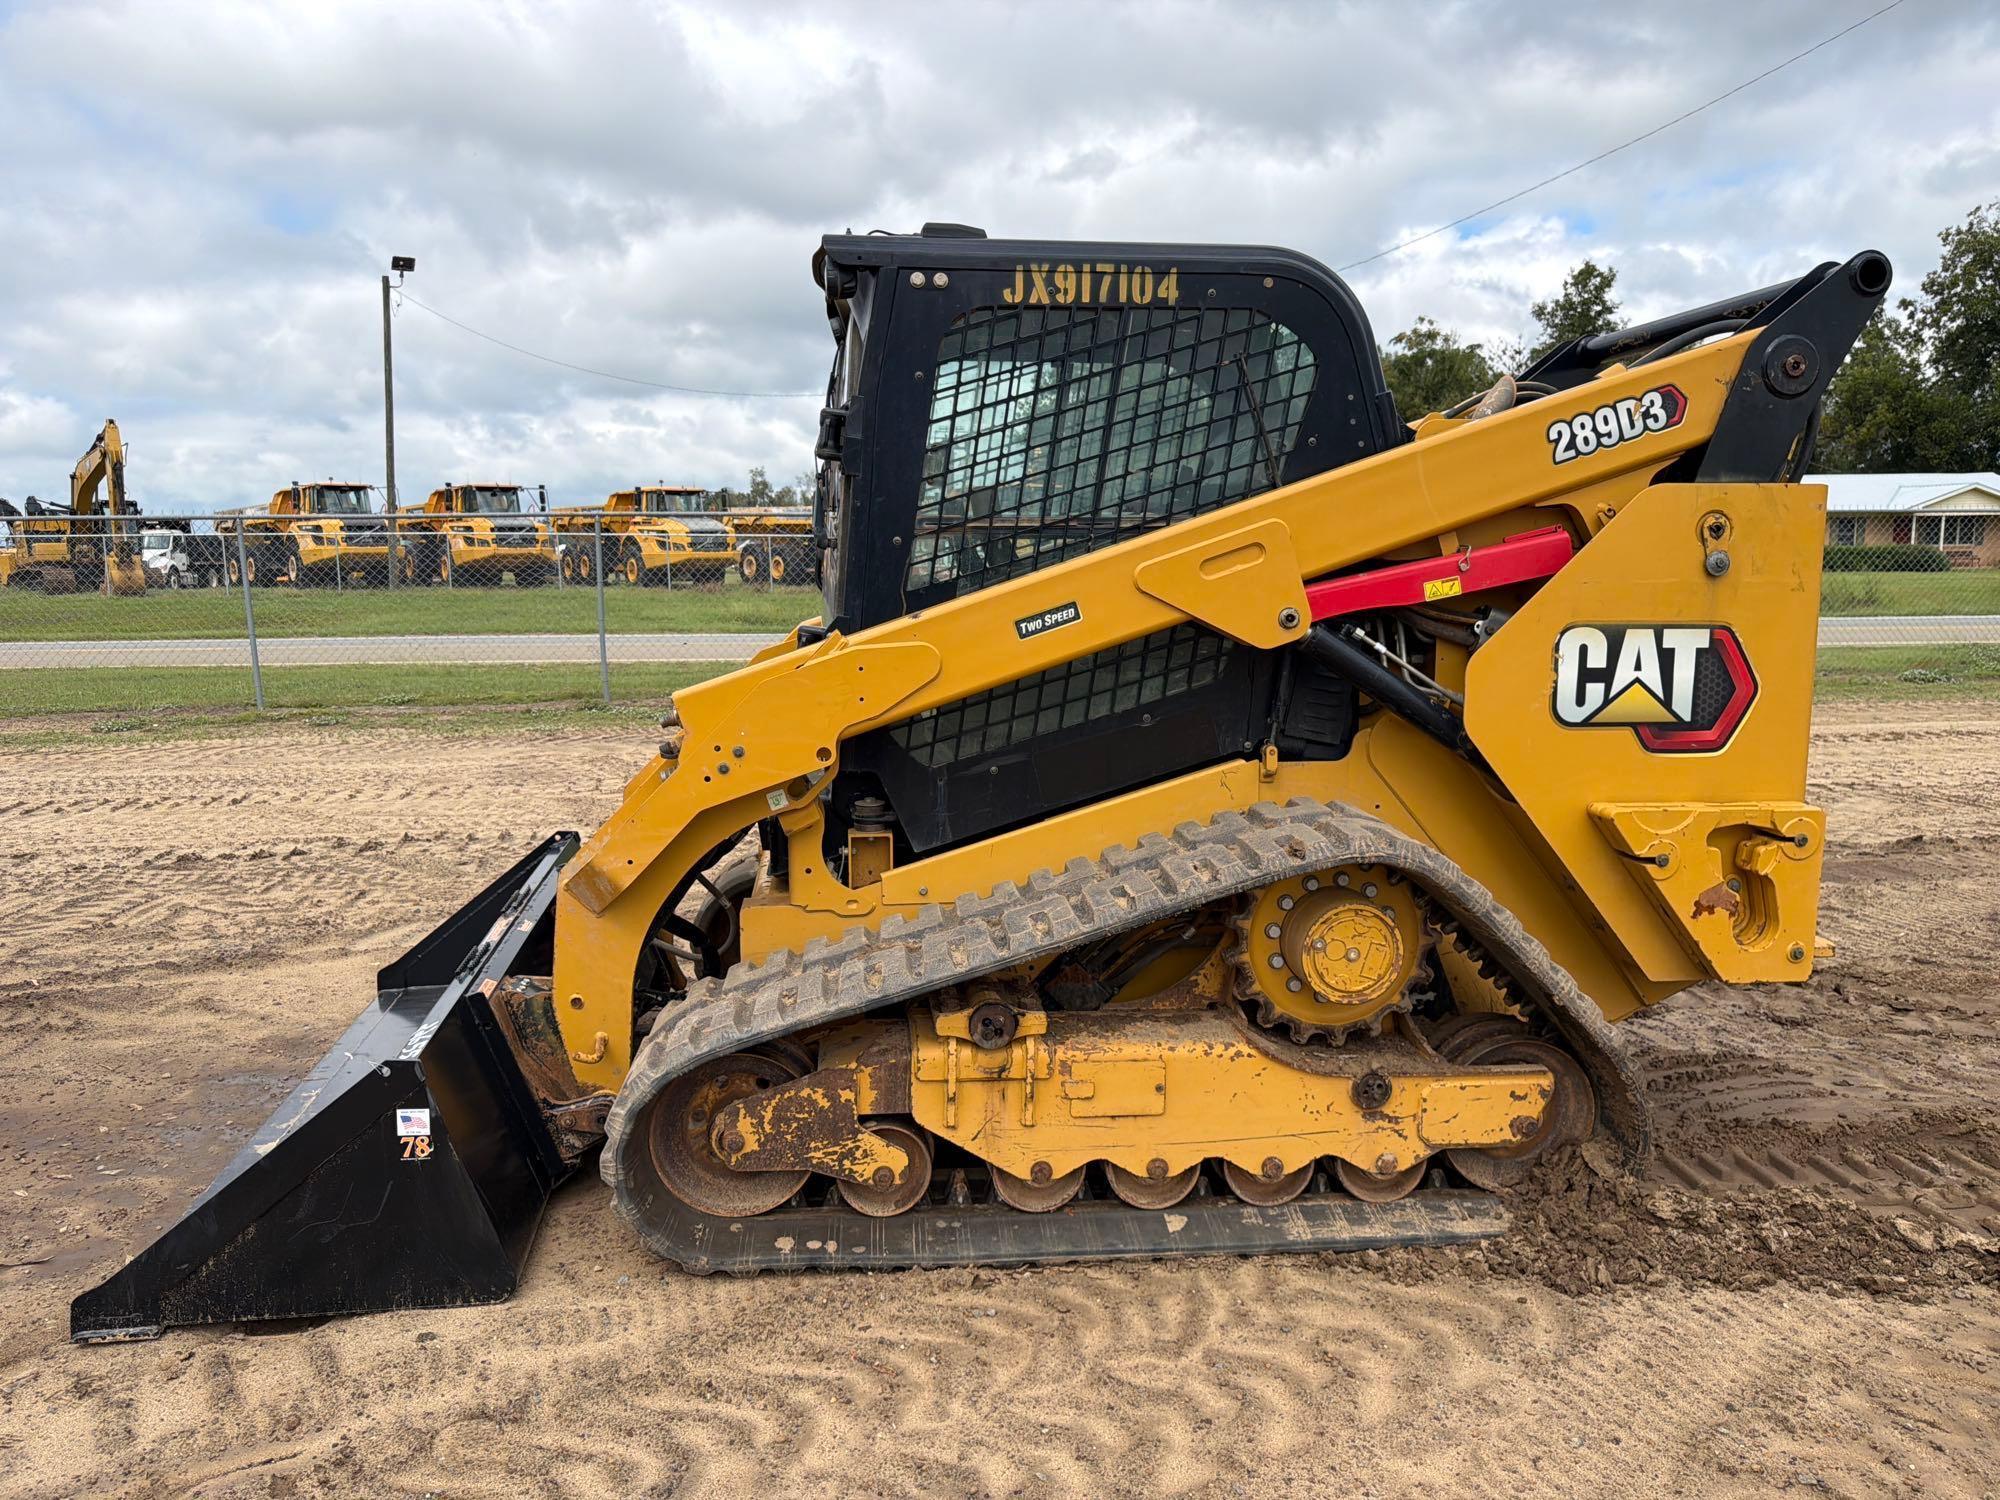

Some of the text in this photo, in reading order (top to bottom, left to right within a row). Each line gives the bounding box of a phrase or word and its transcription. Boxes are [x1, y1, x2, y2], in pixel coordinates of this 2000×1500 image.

[1003, 263, 1179, 306] JX917104
[1548, 391, 1668, 464] 289D3
[1020, 608, 1075, 634] TWO SPEED
[1556, 626, 1711, 723] CAT
[400, 1136, 431, 1158] 78
